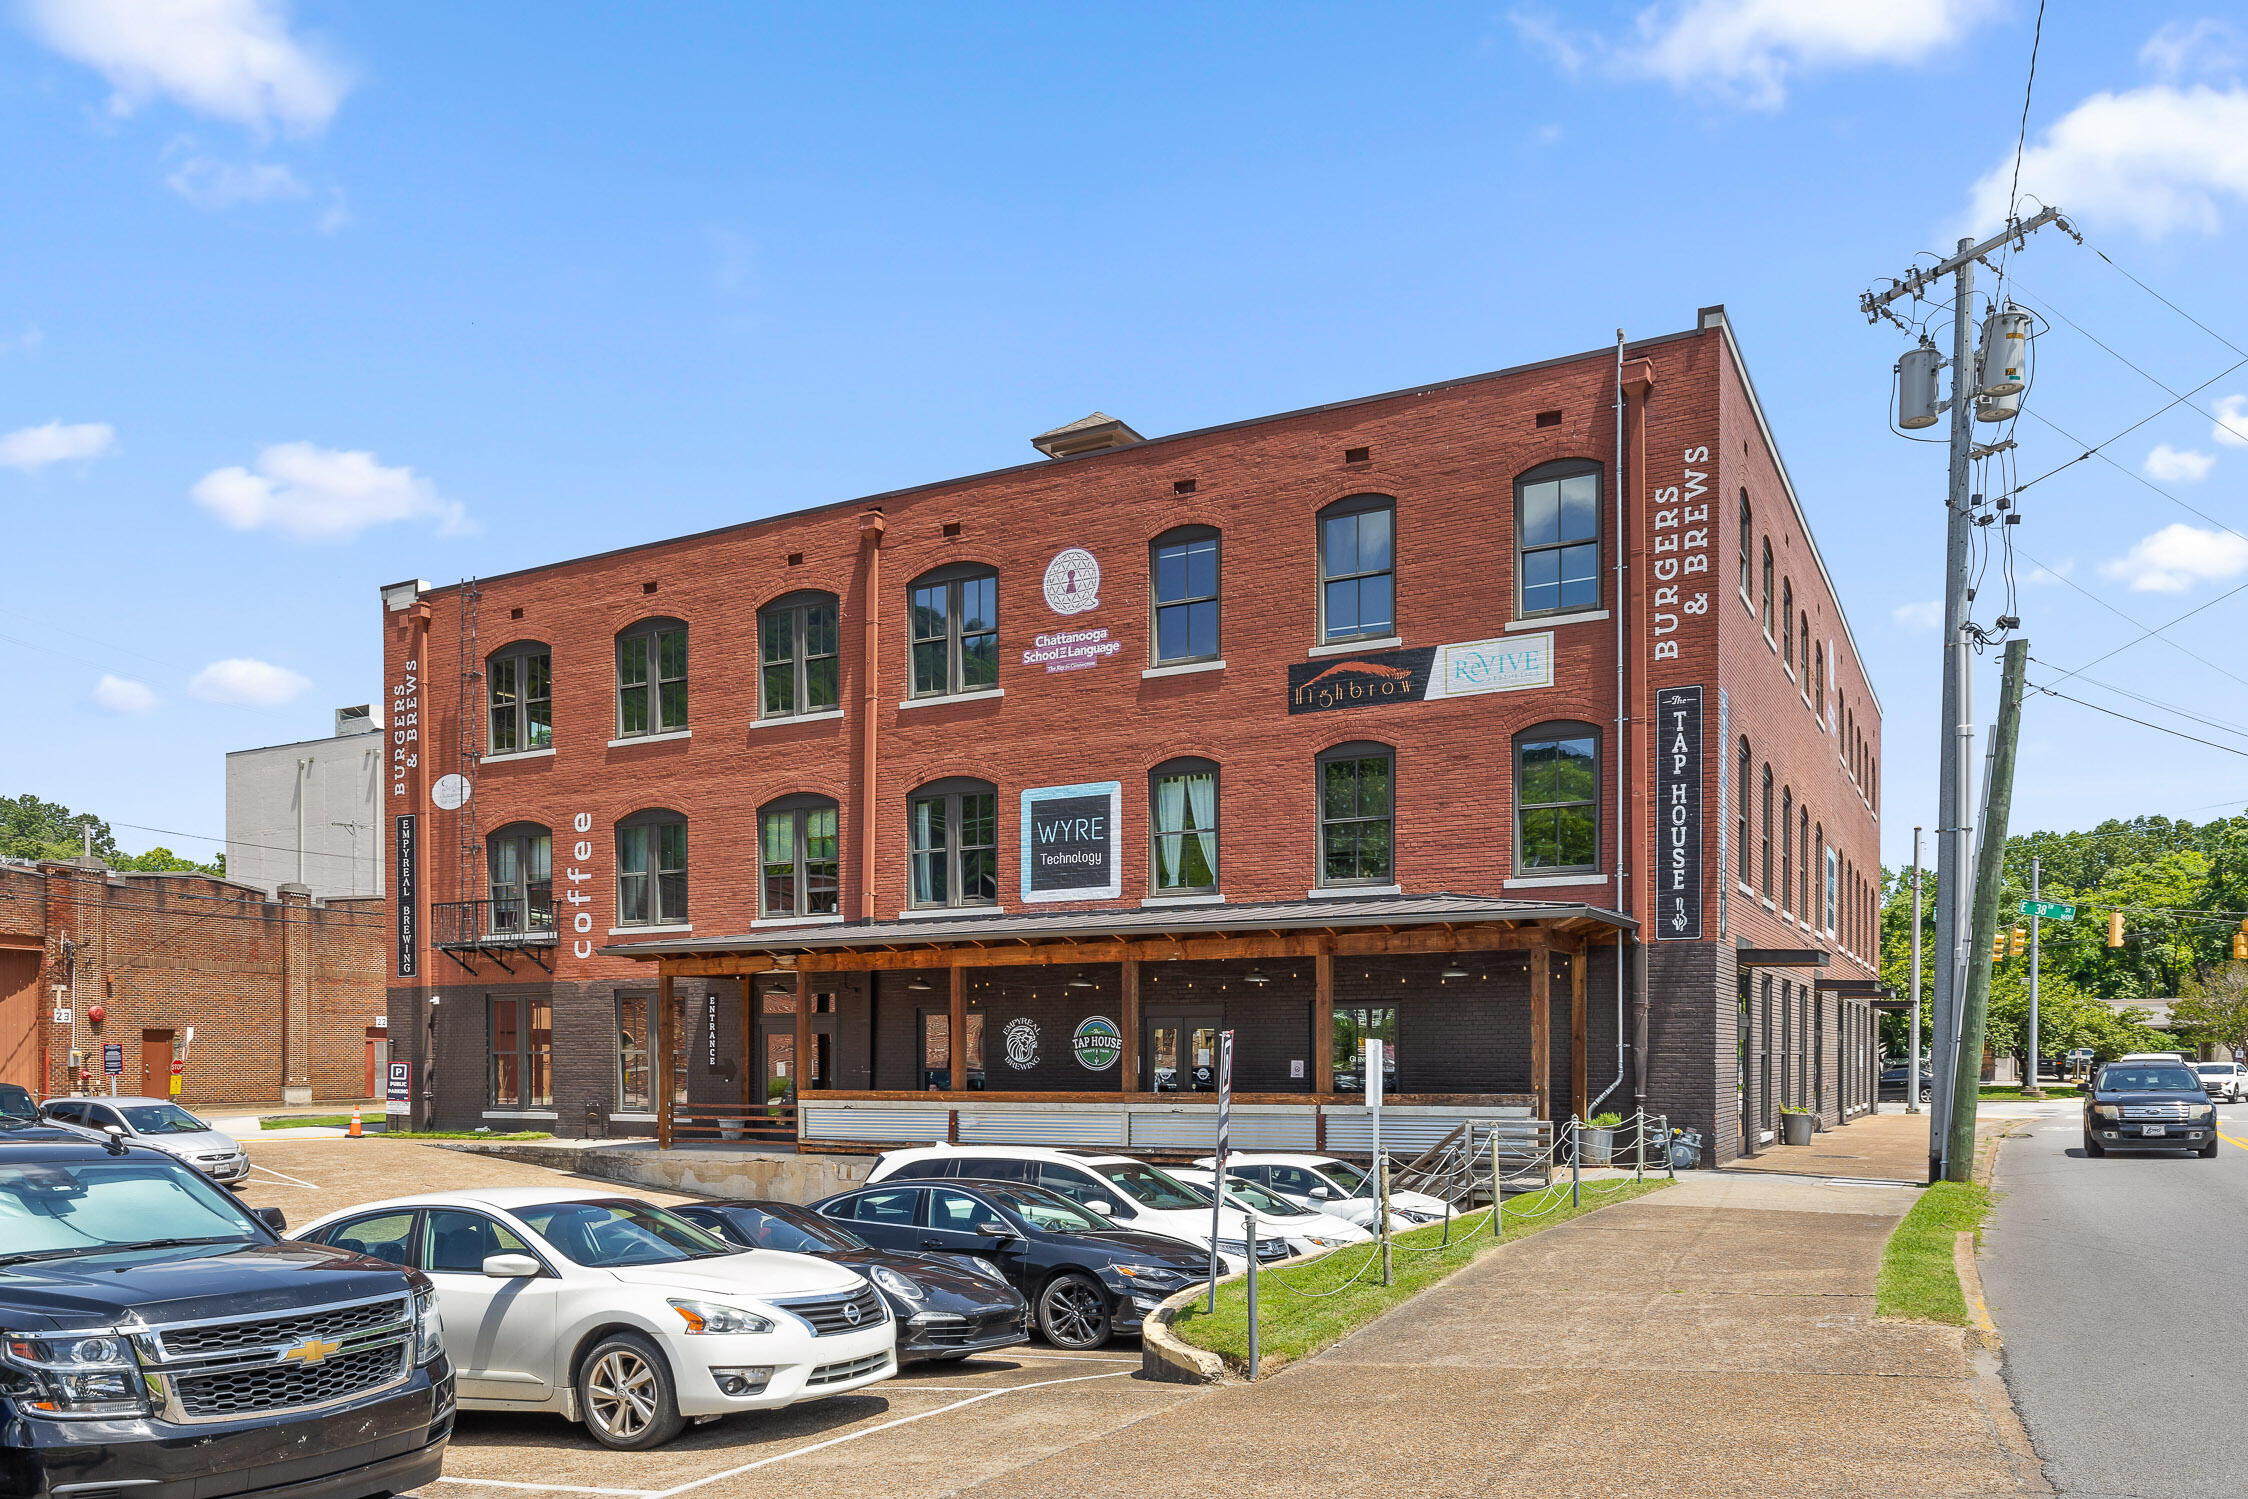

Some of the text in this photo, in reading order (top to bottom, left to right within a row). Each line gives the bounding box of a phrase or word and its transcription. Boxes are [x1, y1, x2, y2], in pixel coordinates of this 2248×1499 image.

[1683, 445, 1709, 615] & BREWS
[1655, 486, 1678, 661] BURGERS
[1035, 629, 1107, 648] Chattanooga
[1023, 647, 1059, 664] School
[1067, 642, 1120, 657] Language
[1295, 680, 1412, 708] Highbrow
[1671, 695, 1687, 705] The
[406, 659, 418, 768] & BREWS
[394, 684, 406, 796] BURGERS
[1671, 710, 1688, 890] TAP HOUSE
[1037, 816, 1105, 844] WYRE
[1040, 850, 1102, 866] Technology
[402, 819, 412, 973] EMPYREAL BREWING
[566, 812, 593, 960] coffee
[2020, 902, 2028, 912] E
[55, 1012, 70, 1021] 23
[1002, 1017, 1041, 1036] EMPYREAL
[1072, 1035, 1122, 1049] TAP HOUSE
[171, 1063, 183, 1071] STOP
[396, 1068, 402, 1076] P
[1004, 1055, 1041, 1071] BREWING
